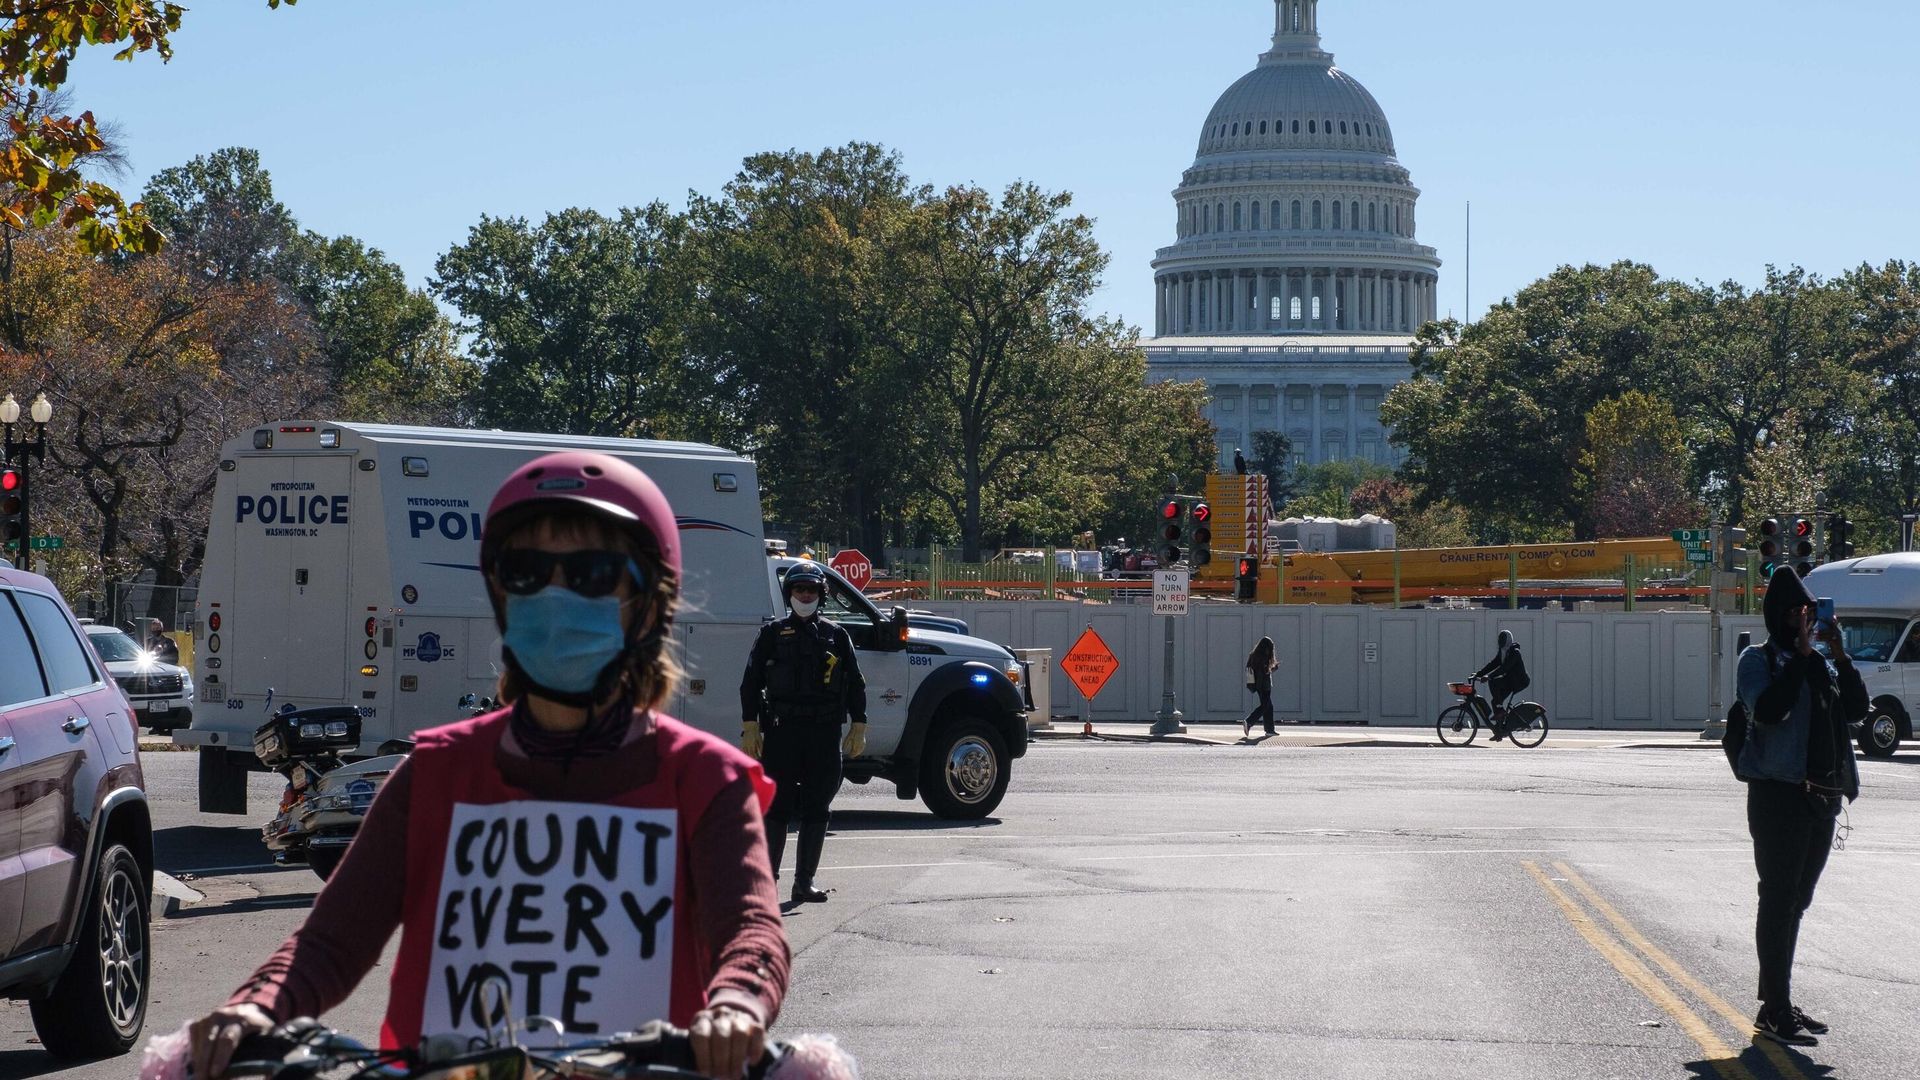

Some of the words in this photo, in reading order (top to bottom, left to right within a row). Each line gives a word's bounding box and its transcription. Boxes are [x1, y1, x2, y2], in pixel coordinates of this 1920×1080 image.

[270, 482, 315, 491] METROPOLITAN
[407, 497, 469, 508] METROPOLITAN
[236, 495, 349, 524] POLICE
[310, 529, 318, 537] DC
[1682, 530, 1691, 540] D
[39, 538, 47, 548] D
[1681, 541, 1700, 549] UNIT
[1164, 574, 1178, 582] NO
[1170, 594, 1187, 602] RED
[403, 648, 416, 657] MP
[443, 648, 455, 657] DC
[909, 655, 932, 666] 8891
[1068, 653, 1112, 663] CONSTRUCTION
[1074, 664, 1105, 673] ENTRANCE
[1080, 675, 1100, 684] AHEAD
[227, 699, 243, 710] SOD
[454, 813, 673, 886] COUNT
[438, 883, 673, 960] EVERY
[445, 960, 600, 1034] VOTE
